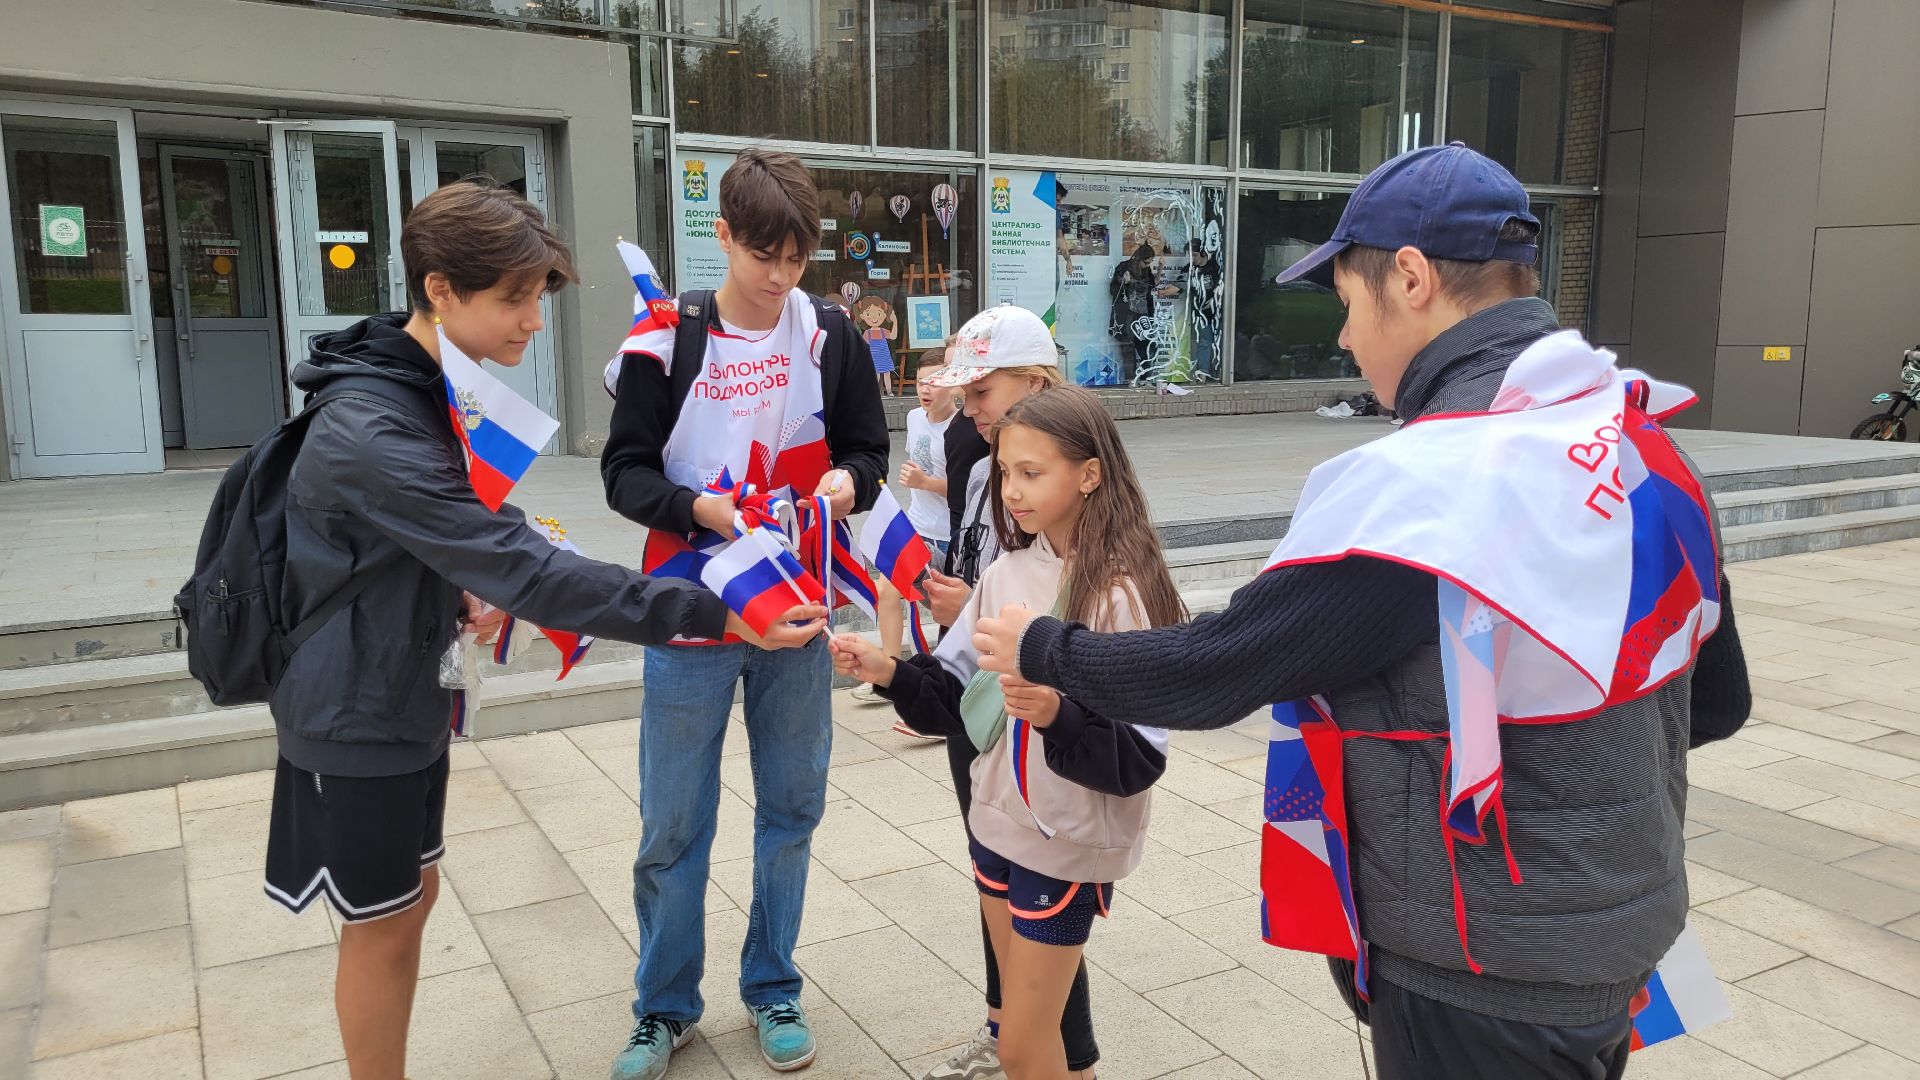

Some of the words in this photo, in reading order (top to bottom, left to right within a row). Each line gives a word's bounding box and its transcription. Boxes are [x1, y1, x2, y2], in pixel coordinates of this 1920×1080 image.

[686, 219, 715, 228] ЦЕНТР
[992, 221, 1043, 229] ЦЕНТРАЛИЗО-
[992, 230, 1022, 238] ВАННАЯ
[992, 239, 1051, 247] БИБЛИОТЕЧНАЯ
[992, 248, 1027, 256] СИСТЕМА
